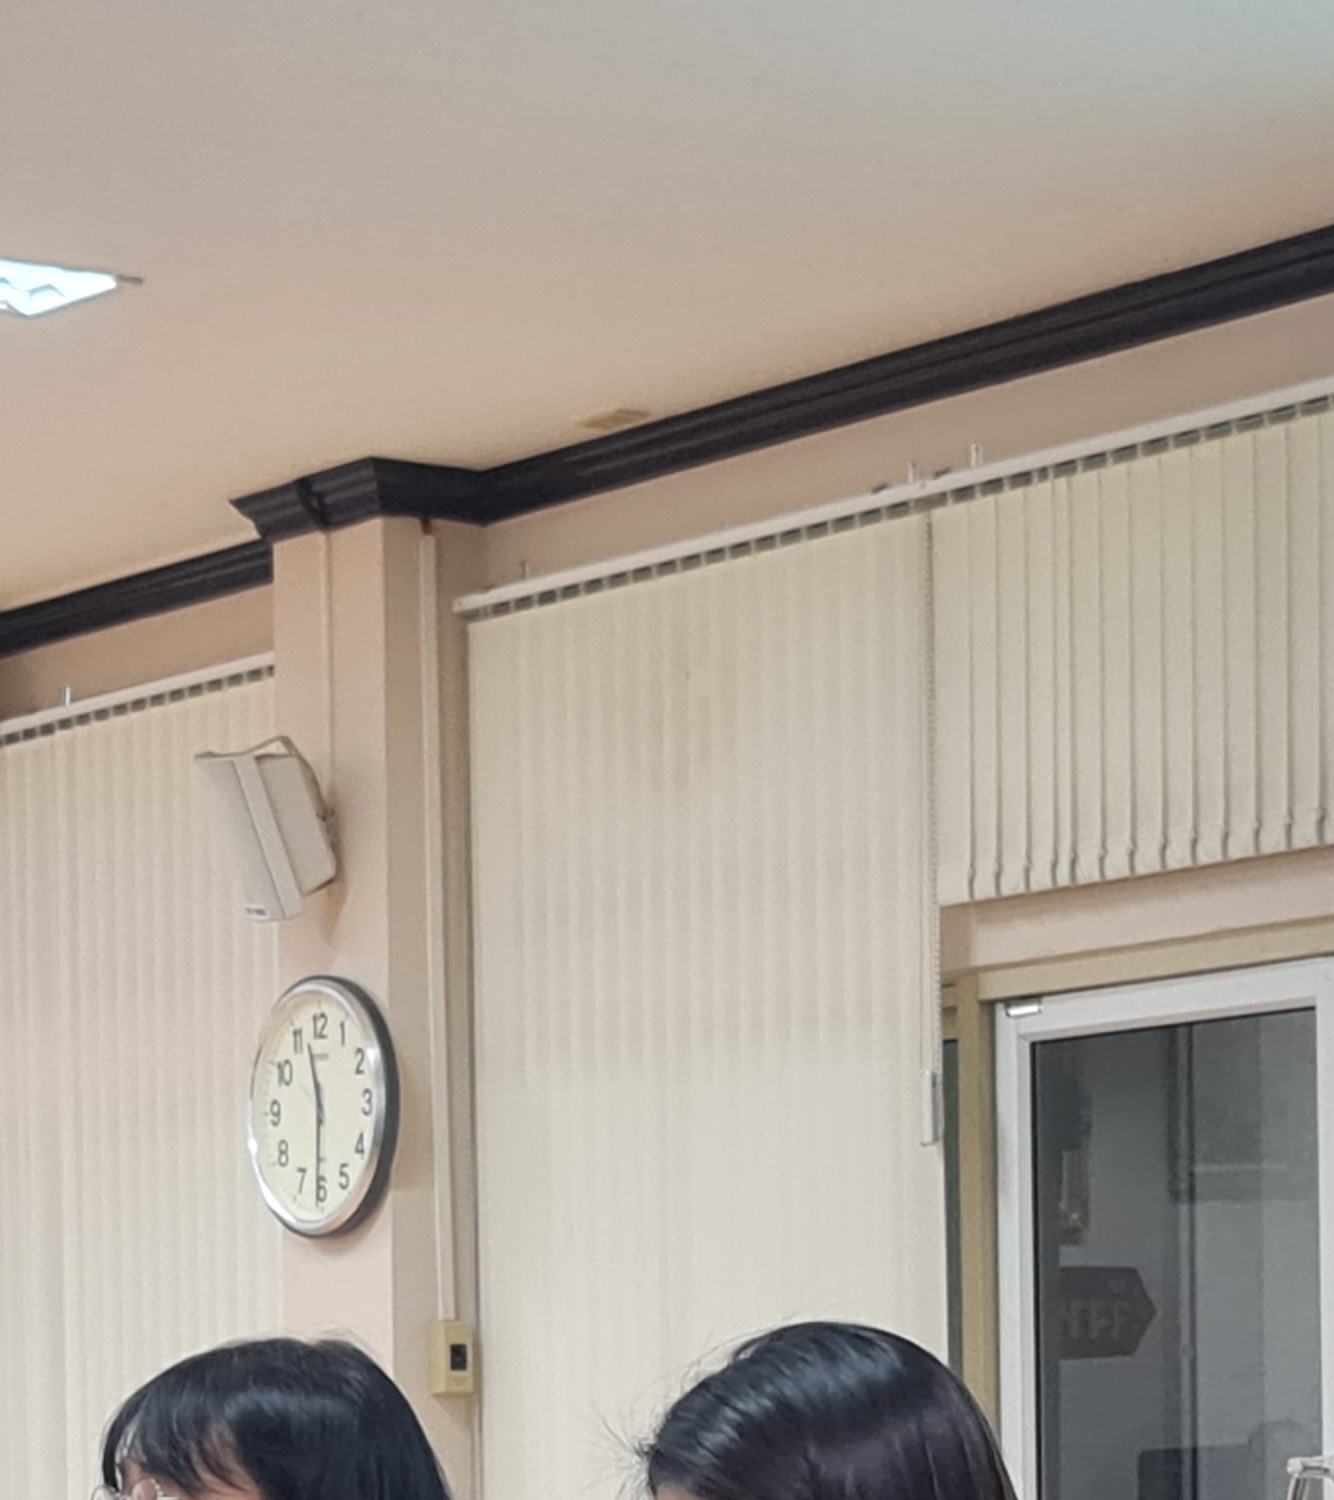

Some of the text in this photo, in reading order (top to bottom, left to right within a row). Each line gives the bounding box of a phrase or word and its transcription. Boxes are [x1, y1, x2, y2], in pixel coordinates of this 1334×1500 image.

[312, 1012, 328, 1040] 12
[339, 1020, 346, 1047] 1
[292, 1028, 304, 1054] 11
[277, 1059, 293, 1087] 10
[354, 1047, 365, 1075] 2
[269, 1099, 281, 1127] 9
[361, 1088, 373, 1117] 3
[277, 1139, 289, 1168] 8
[354, 1132, 365, 1160] 4
[296, 1168, 308, 1195] 7
[316, 1176, 328, 1203] 6
[338, 1163, 350, 1191] 5
